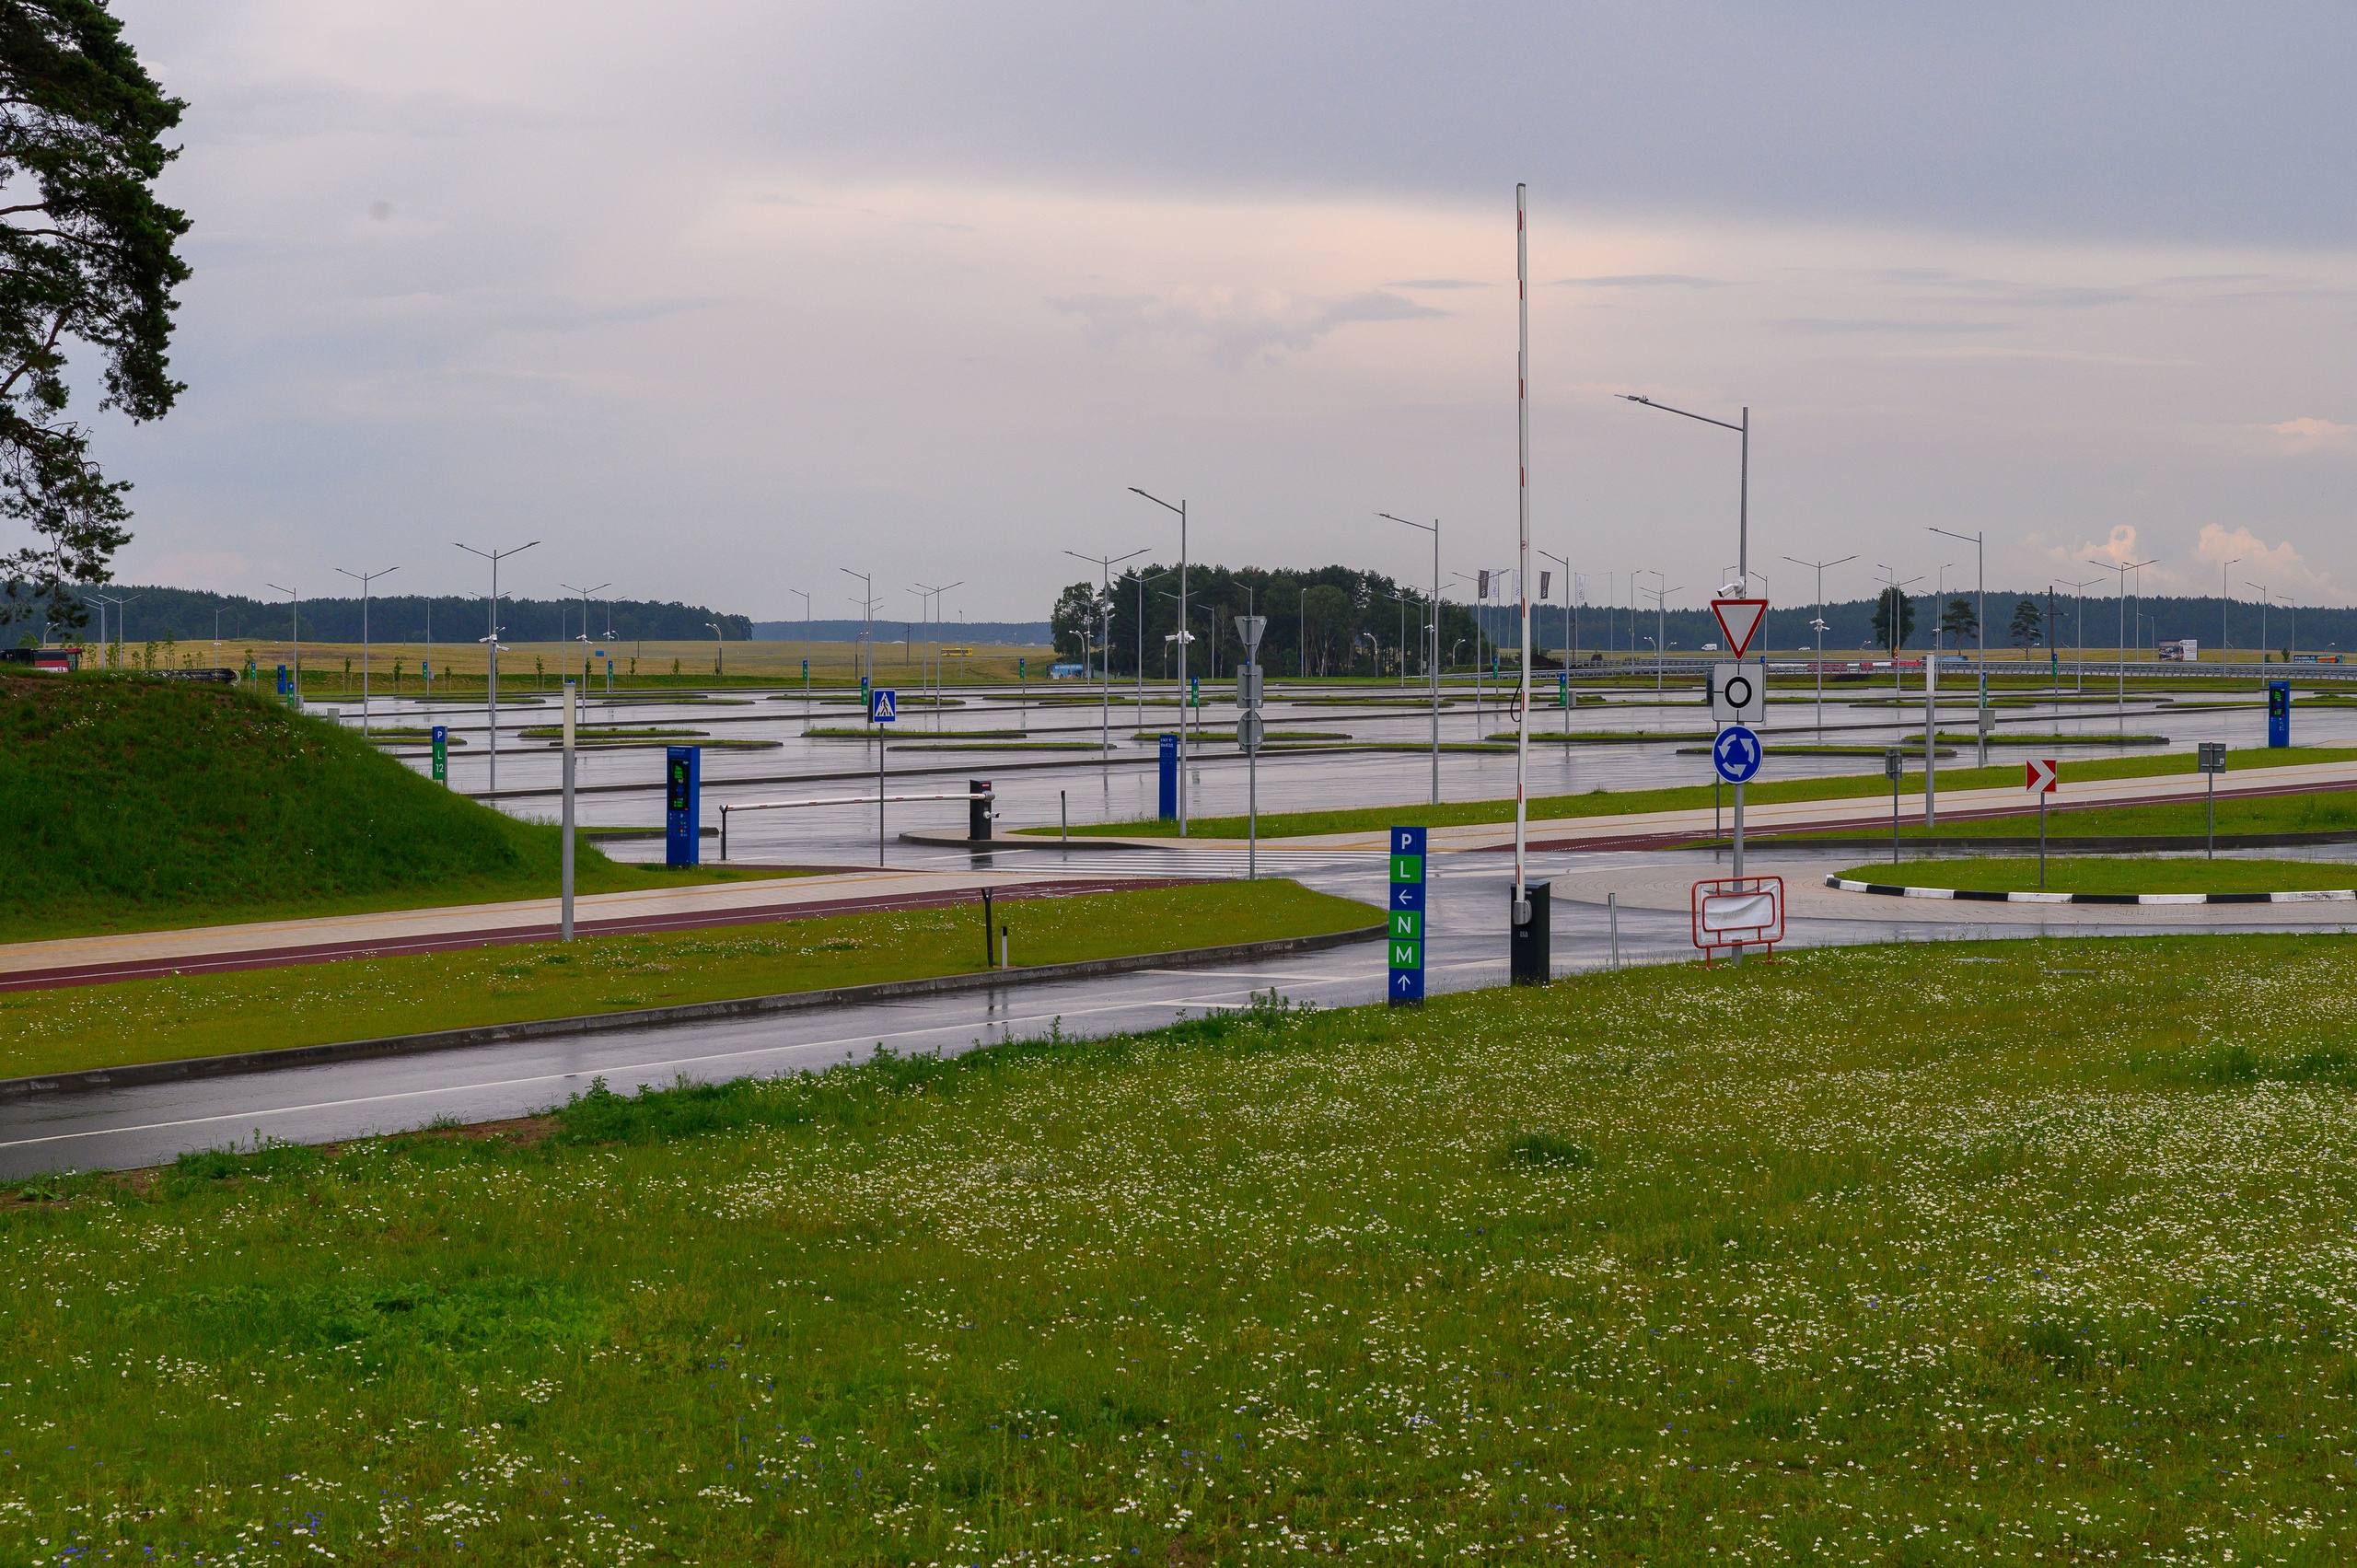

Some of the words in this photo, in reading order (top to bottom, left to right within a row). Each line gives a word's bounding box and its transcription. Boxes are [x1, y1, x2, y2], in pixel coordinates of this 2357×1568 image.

[437, 730, 443, 739] P
[437, 750, 443, 760] L
[435, 763, 444, 772] 12
[1401, 833, 1412, 850] P
[1399, 860, 1411, 878] L
[1398, 916, 1411, 934] N
[1396, 946, 1412, 964] M
